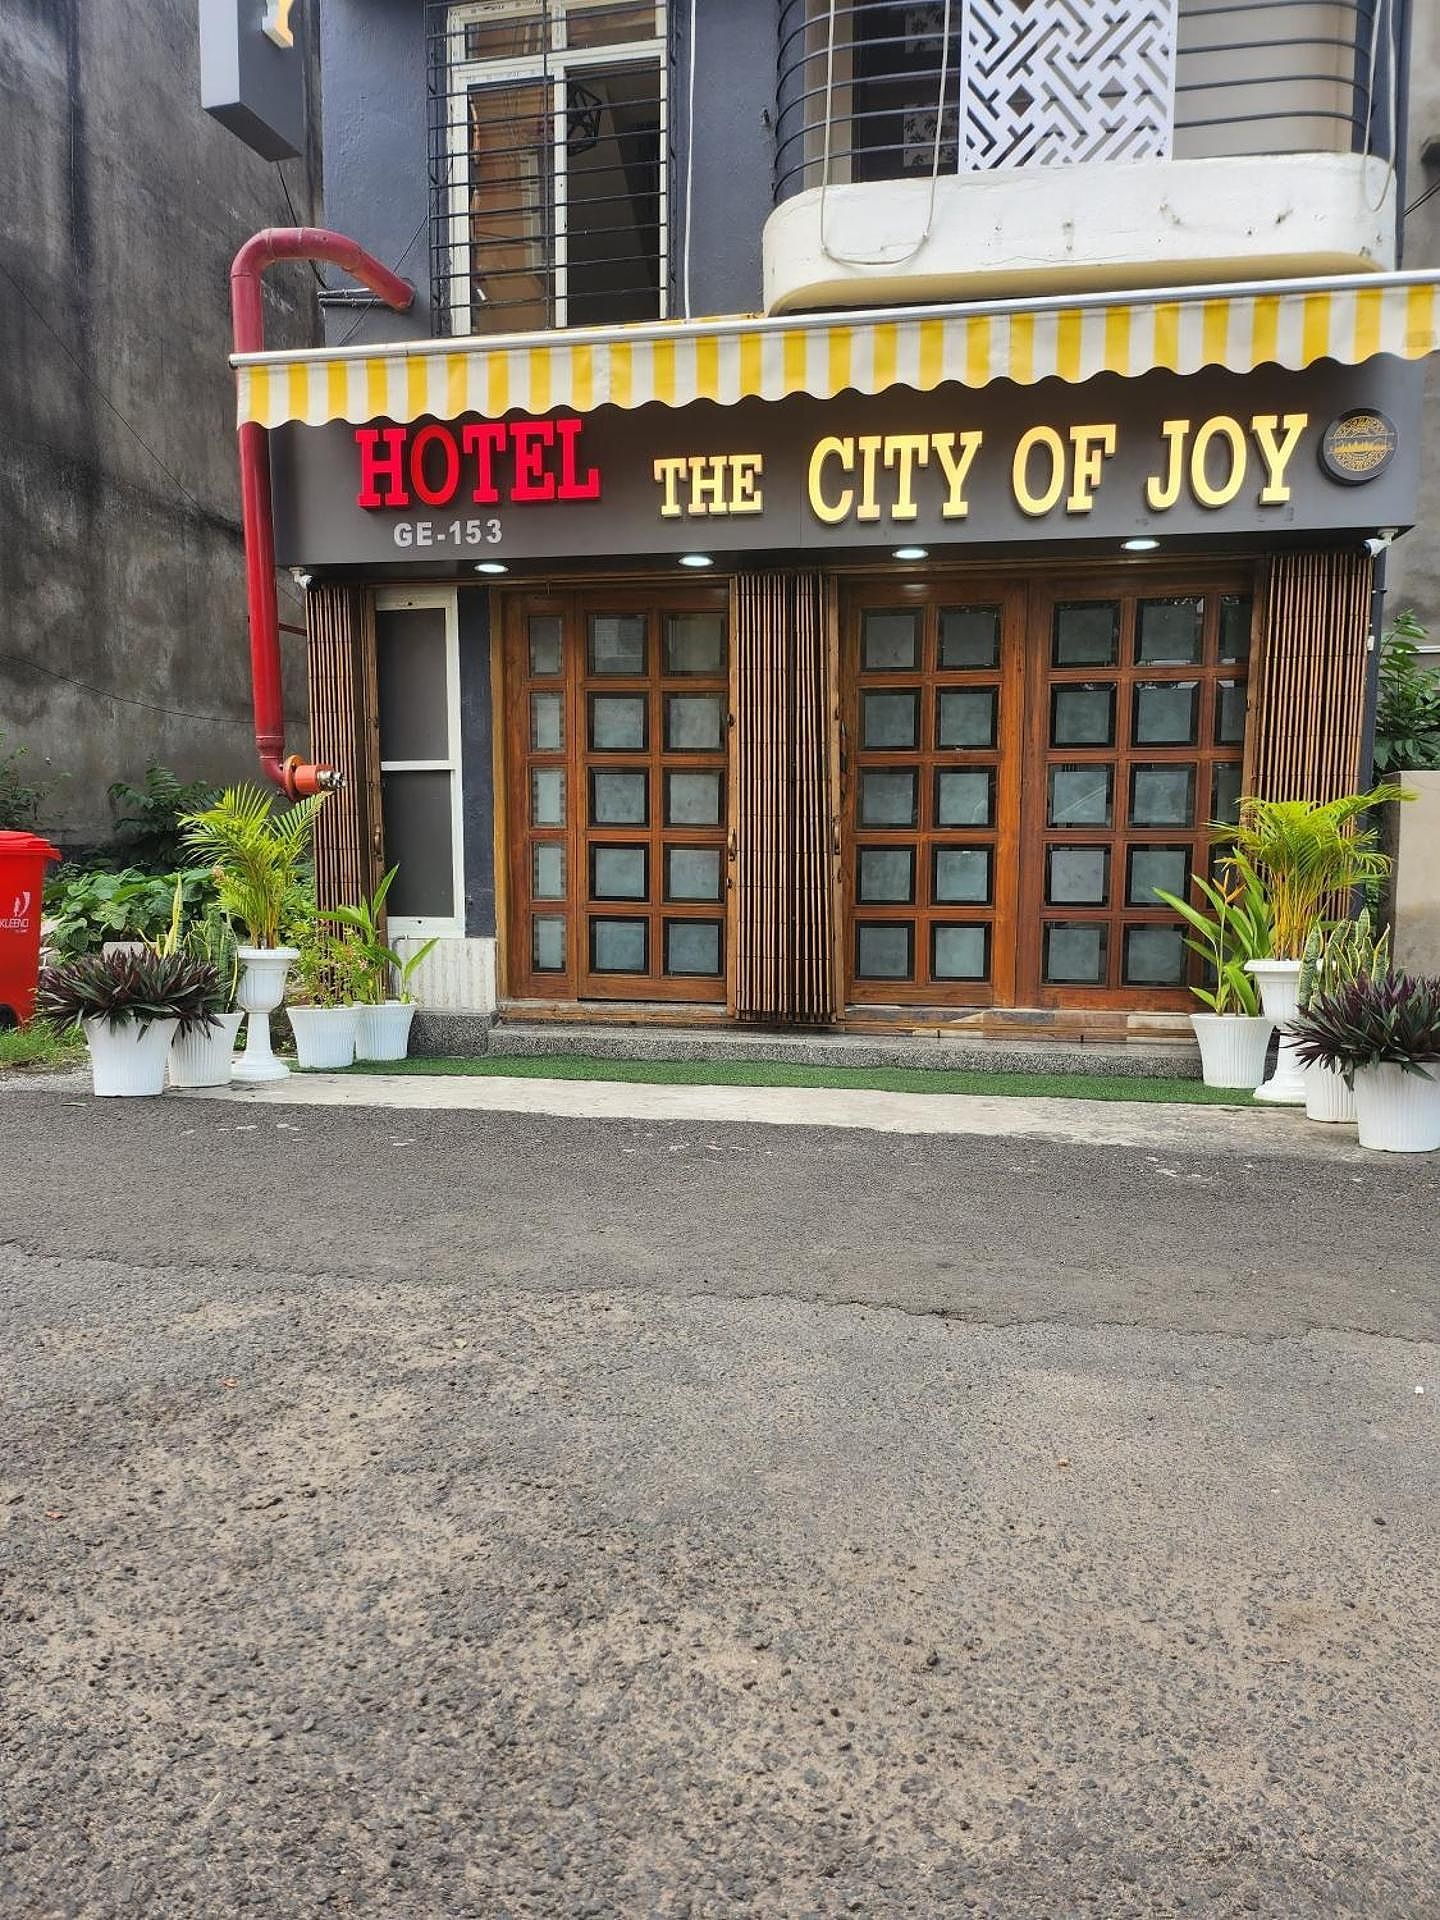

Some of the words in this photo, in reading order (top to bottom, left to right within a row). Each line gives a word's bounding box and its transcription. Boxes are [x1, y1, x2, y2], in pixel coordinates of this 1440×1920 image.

[355, 419, 601, 508] HOTEL
[653, 453, 764, 517] THE
[808, 430, 983, 524] CITY
[1012, 423, 1117, 517] OF
[1146, 413, 1308, 509] JOY
[393, 518, 503, 547] GE-153
